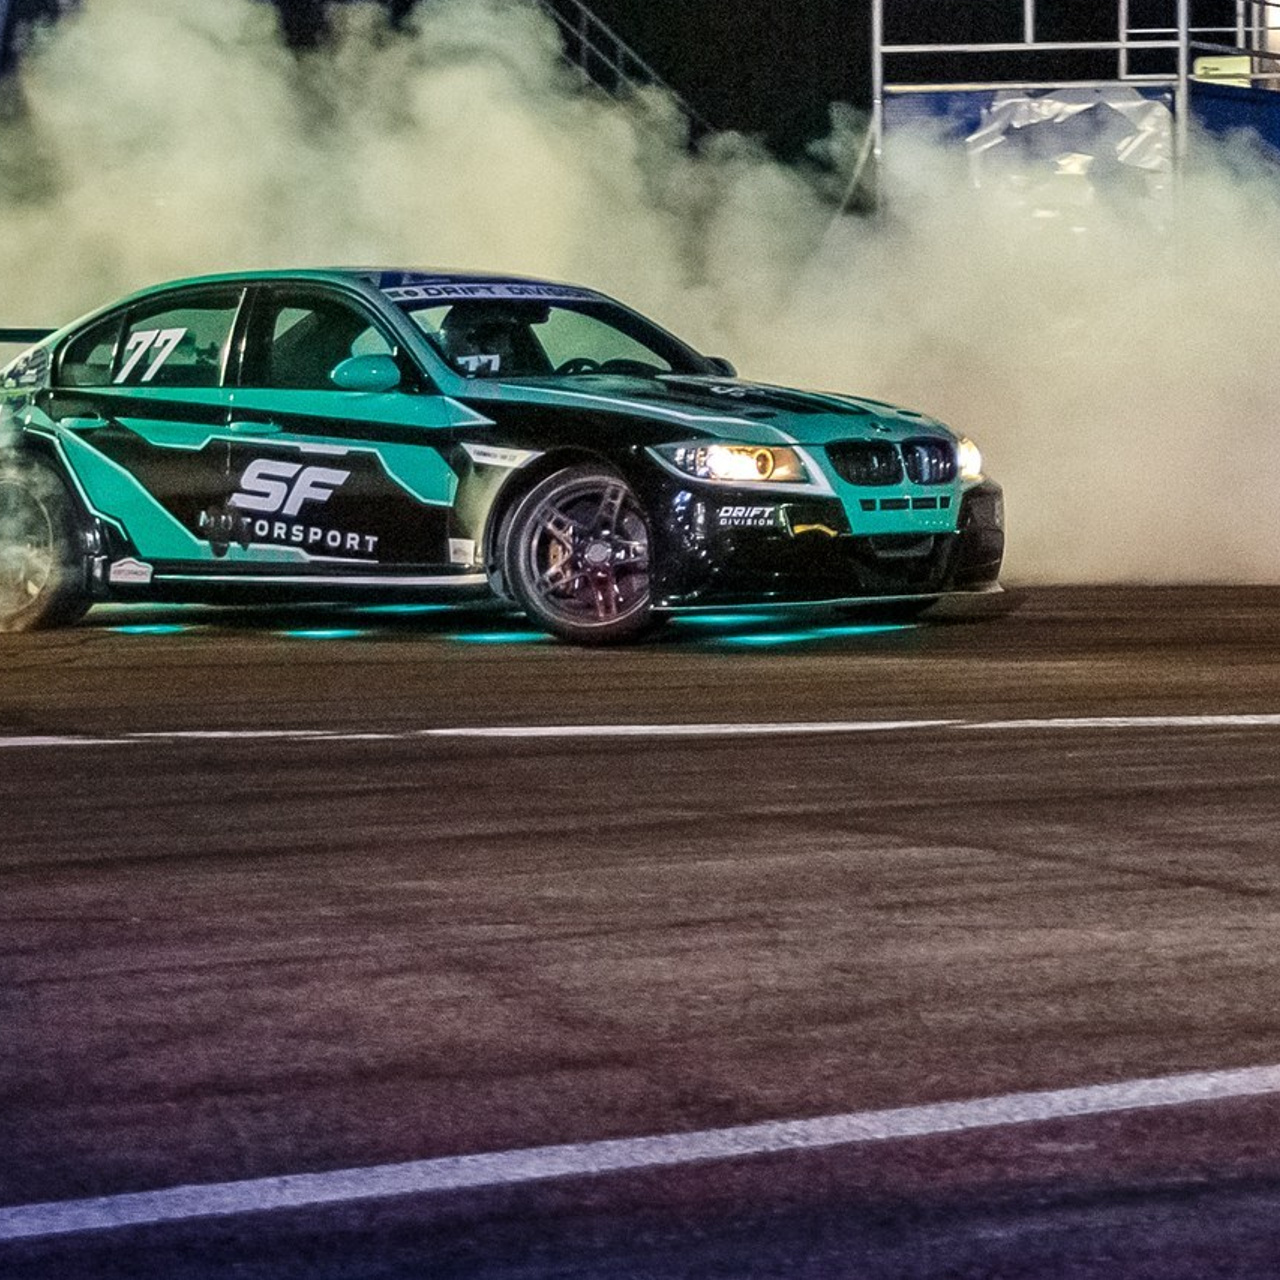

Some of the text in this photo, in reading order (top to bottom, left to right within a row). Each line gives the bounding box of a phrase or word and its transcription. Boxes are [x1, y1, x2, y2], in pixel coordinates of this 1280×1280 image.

[421, 285, 495, 298] DRIFT
[112, 327, 188, 384] 77
[228, 458, 351, 517] SF
[719, 506, 775, 518] DRIFT
[720, 518, 774, 526] DIVISION
